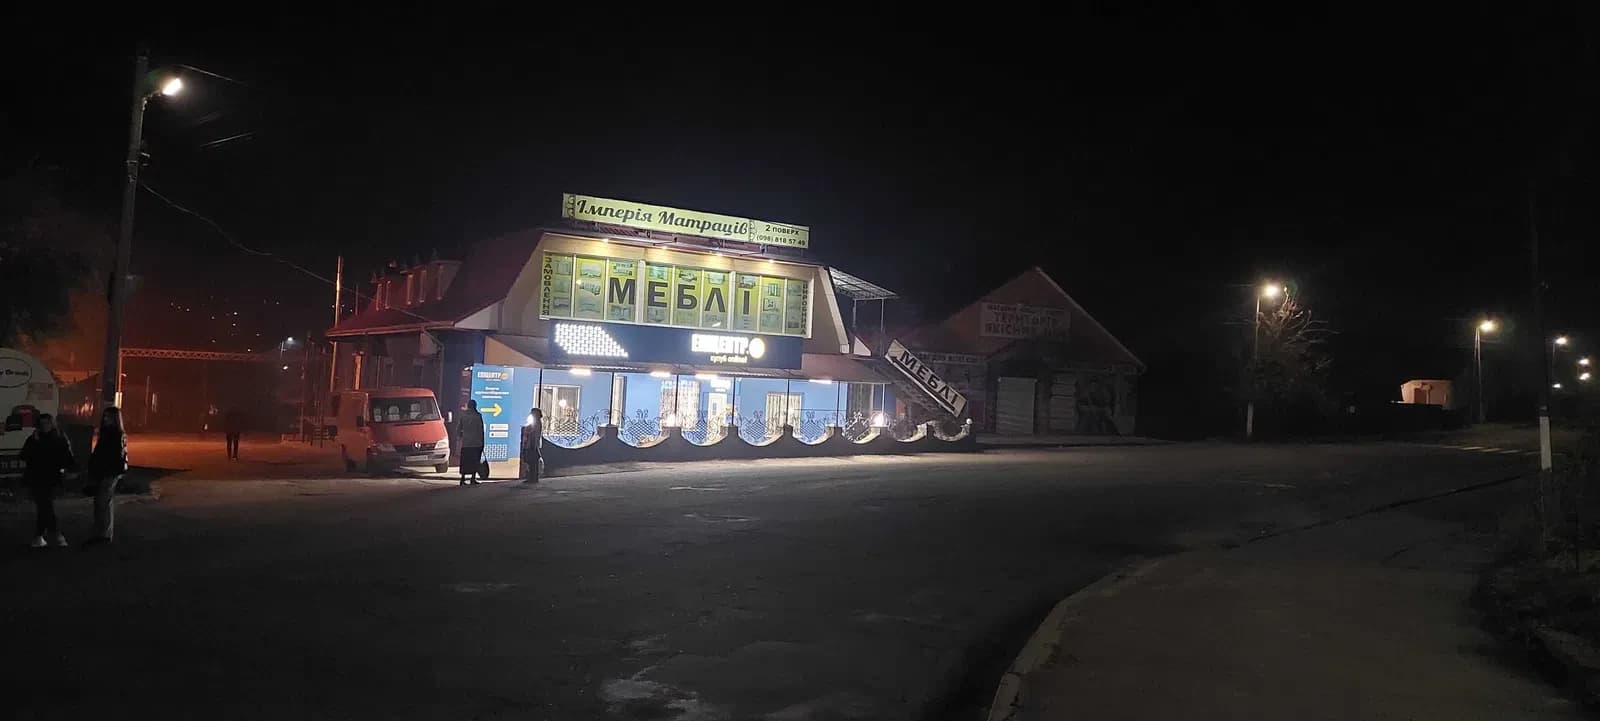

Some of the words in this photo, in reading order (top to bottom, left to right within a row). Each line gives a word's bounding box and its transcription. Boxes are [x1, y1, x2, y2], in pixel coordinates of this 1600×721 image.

[576, 200, 652, 222] Імперія
[658, 211, 748, 235] Матраців
[765, 224, 771, 232] 2
[608, 277, 750, 315] МЕБЛІ
[900, 350, 957, 404] МЕБЛІ
